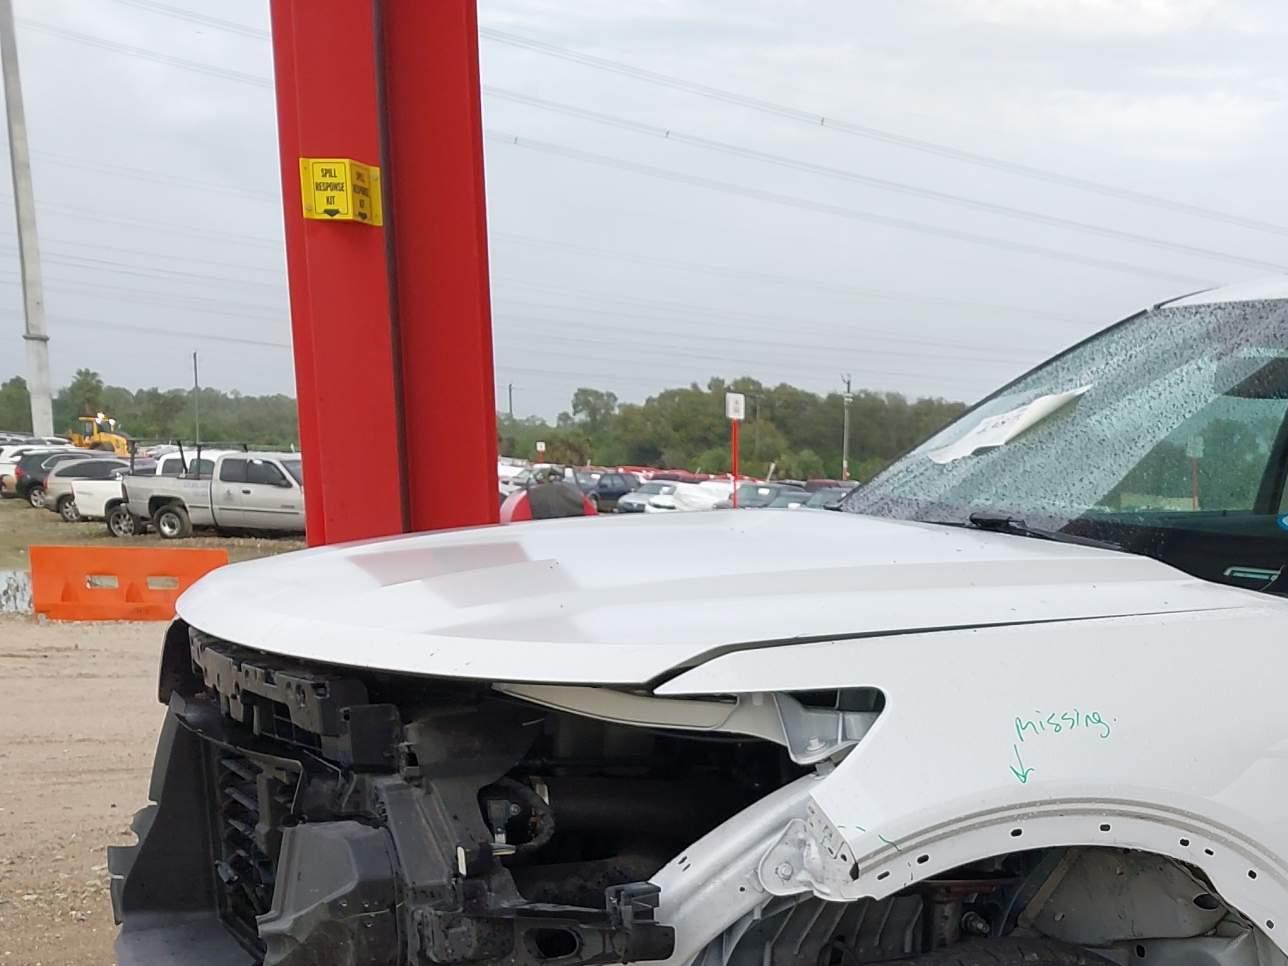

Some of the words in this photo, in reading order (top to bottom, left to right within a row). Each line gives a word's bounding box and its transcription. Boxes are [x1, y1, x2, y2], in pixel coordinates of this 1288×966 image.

[320, 168, 338, 178] SPILL
[315, 182, 345, 192] RESPONSE
[326, 196, 335, 206] KIT
